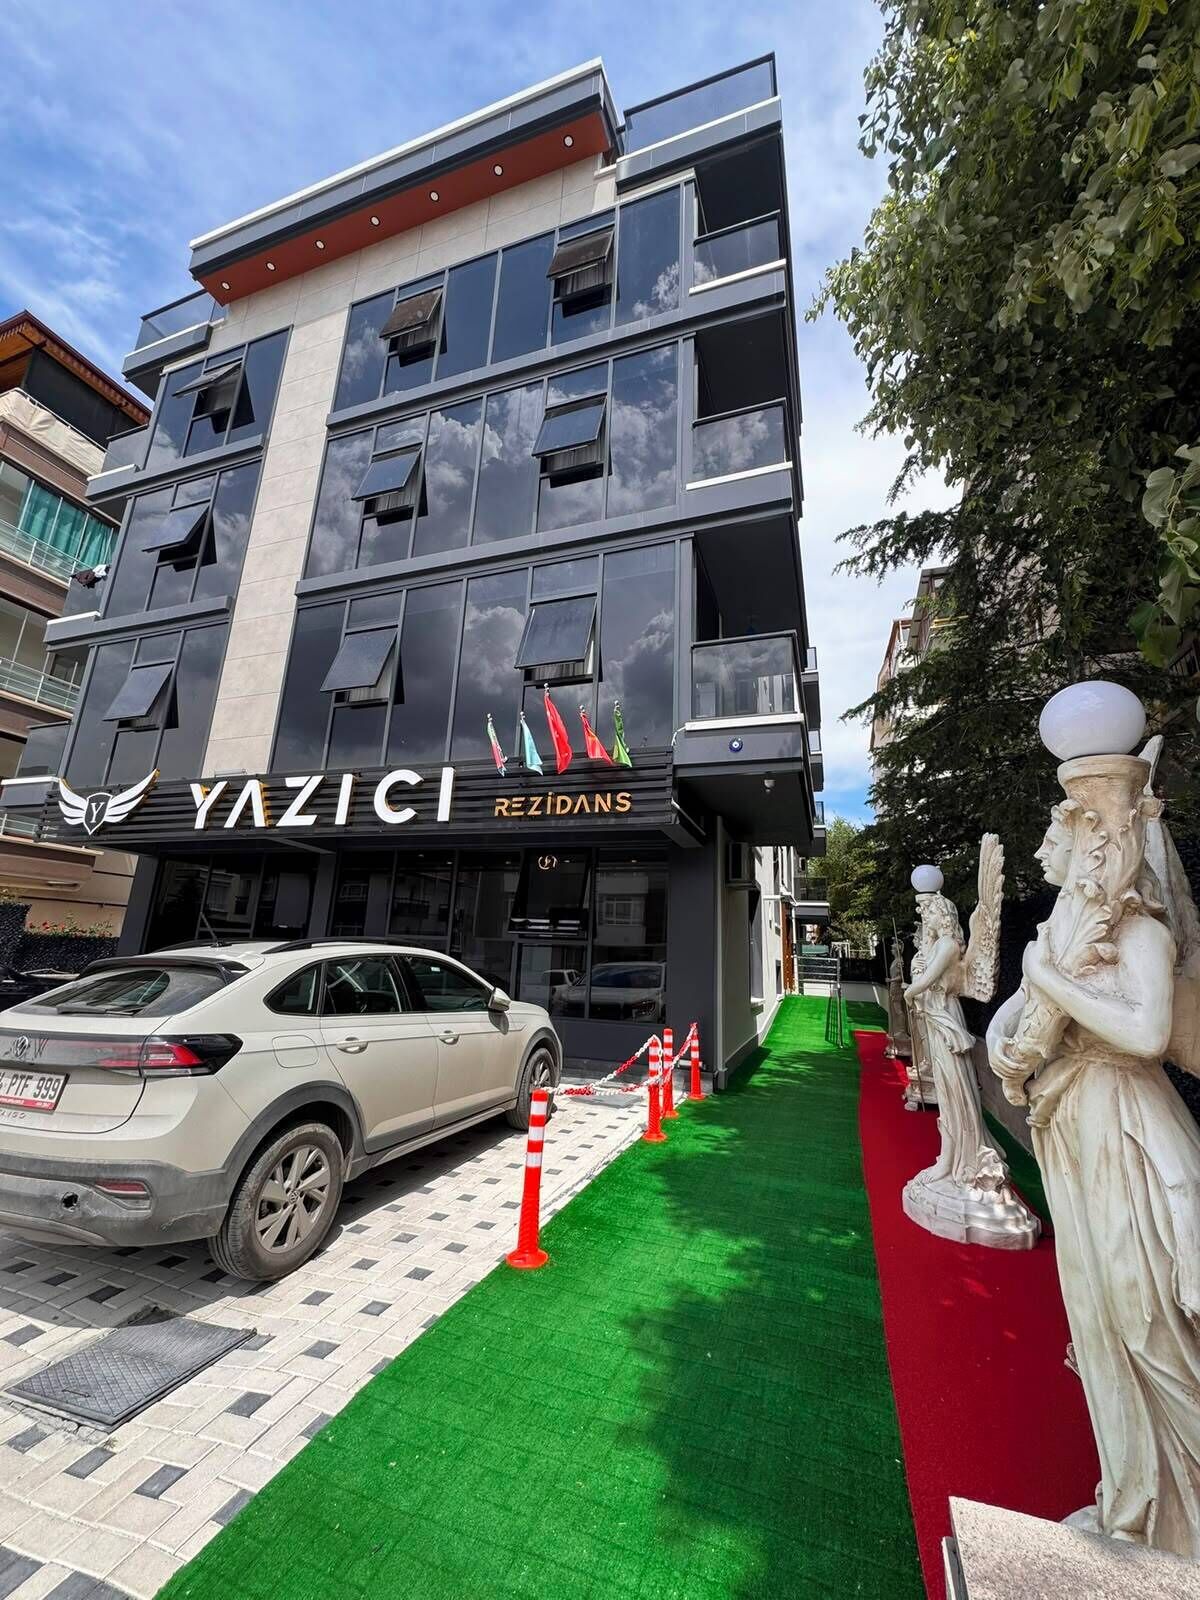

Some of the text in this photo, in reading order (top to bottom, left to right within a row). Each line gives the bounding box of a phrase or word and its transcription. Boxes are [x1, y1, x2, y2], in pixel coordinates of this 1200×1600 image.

[189, 767, 633, 829] YAZICI REZİDANS
[90, 801, 105, 824] Y
[6, 1073, 33, 1096] PTF
[33, 1076, 61, 1100] 999
